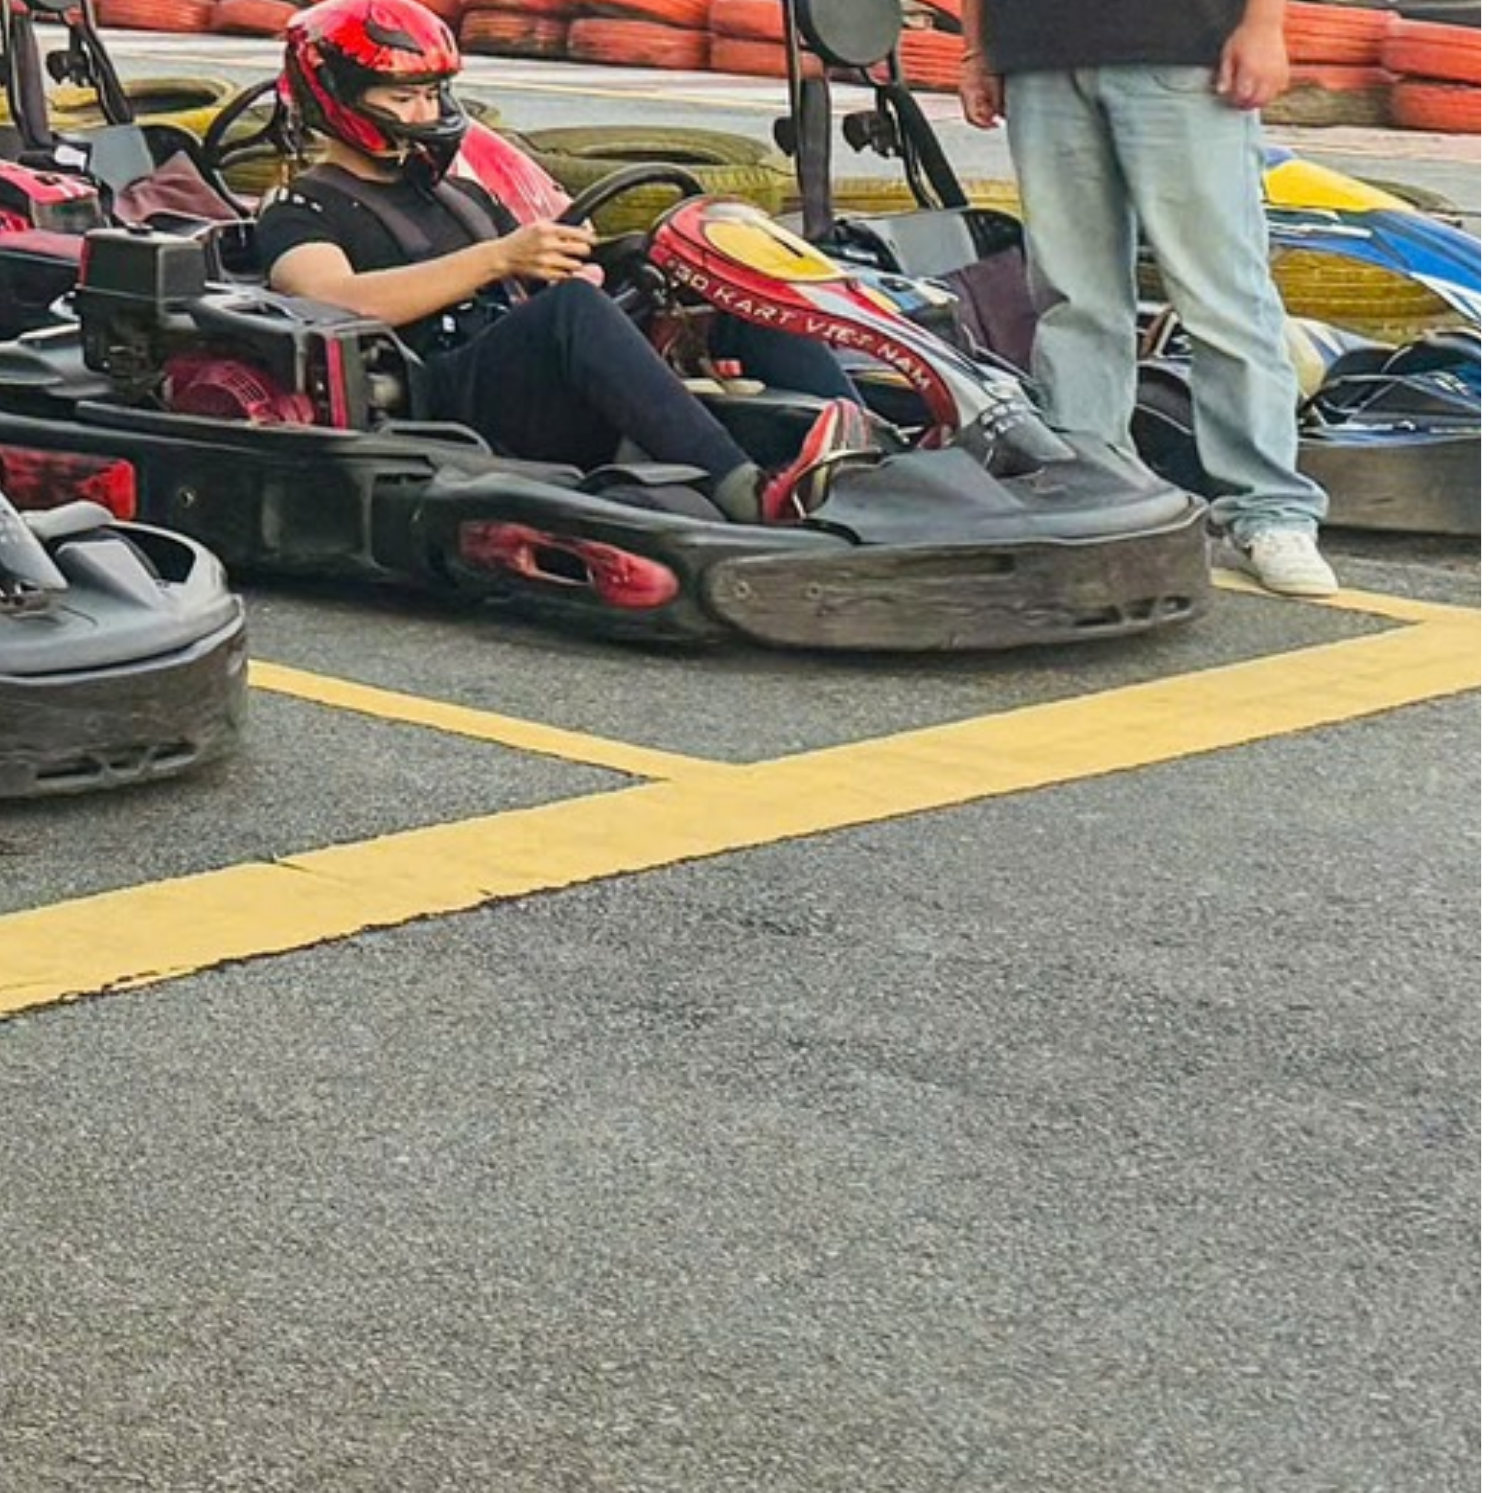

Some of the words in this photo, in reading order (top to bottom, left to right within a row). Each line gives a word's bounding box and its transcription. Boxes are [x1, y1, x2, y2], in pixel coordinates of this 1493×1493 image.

[713, 286, 798, 325] KART
[806, 316, 874, 346] VIET
[876, 342, 932, 391] NAM
